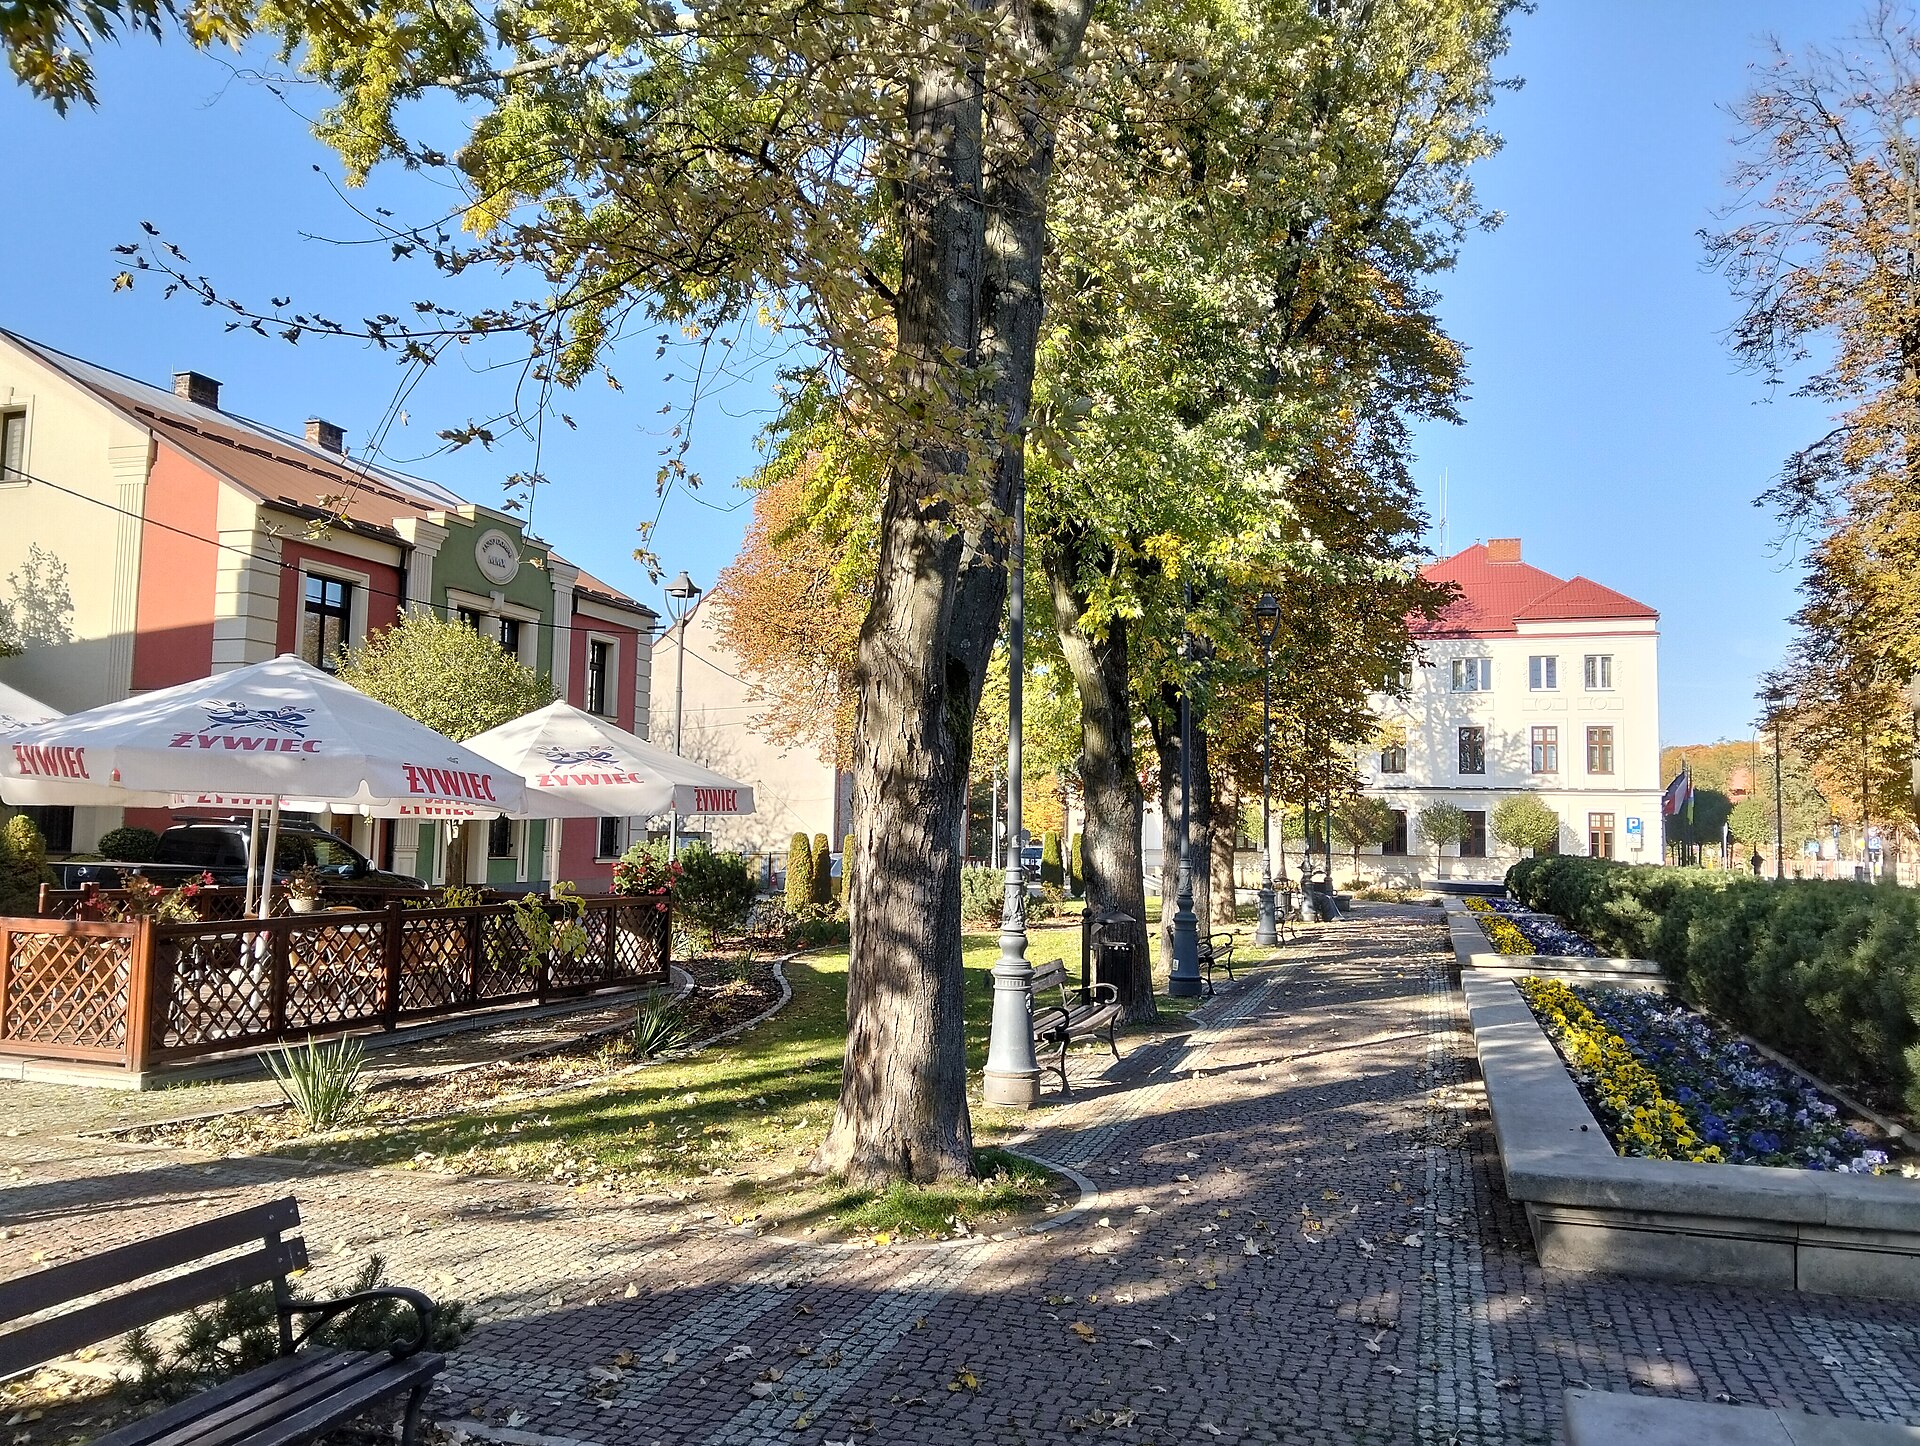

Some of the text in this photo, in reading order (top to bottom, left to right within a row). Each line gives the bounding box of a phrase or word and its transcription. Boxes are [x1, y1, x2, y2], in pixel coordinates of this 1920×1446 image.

[169, 732, 322, 753] ŻYWIEC
[12, 741, 89, 779] ŻYWIEC
[402, 763, 497, 802] ŻYWIEC
[537, 771, 643, 787] ŻYWIEC
[693, 786, 738, 812] ŻYWIEC
[1628, 818, 1639, 830] P
